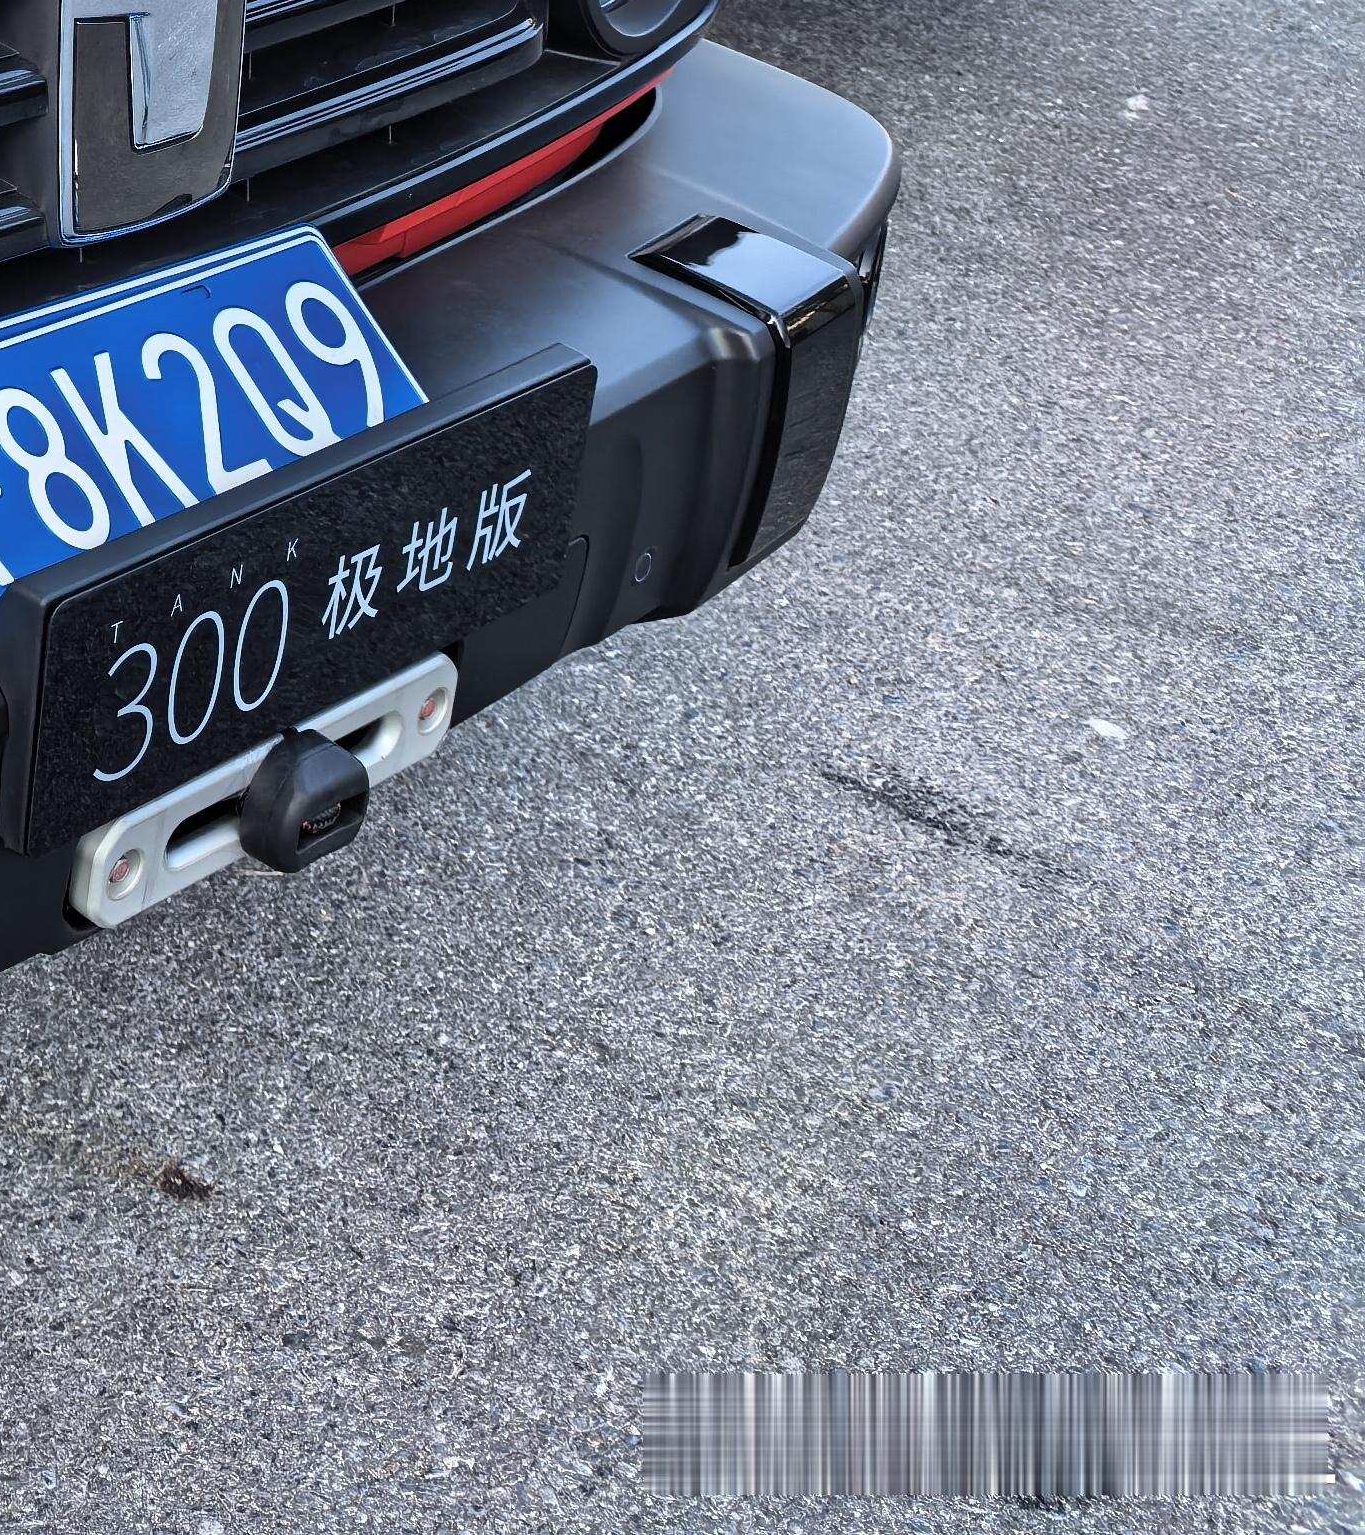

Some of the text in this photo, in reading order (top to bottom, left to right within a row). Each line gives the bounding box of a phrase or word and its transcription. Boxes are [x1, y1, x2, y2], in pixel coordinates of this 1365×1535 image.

[92, 468, 533, 782] 300 极地版
